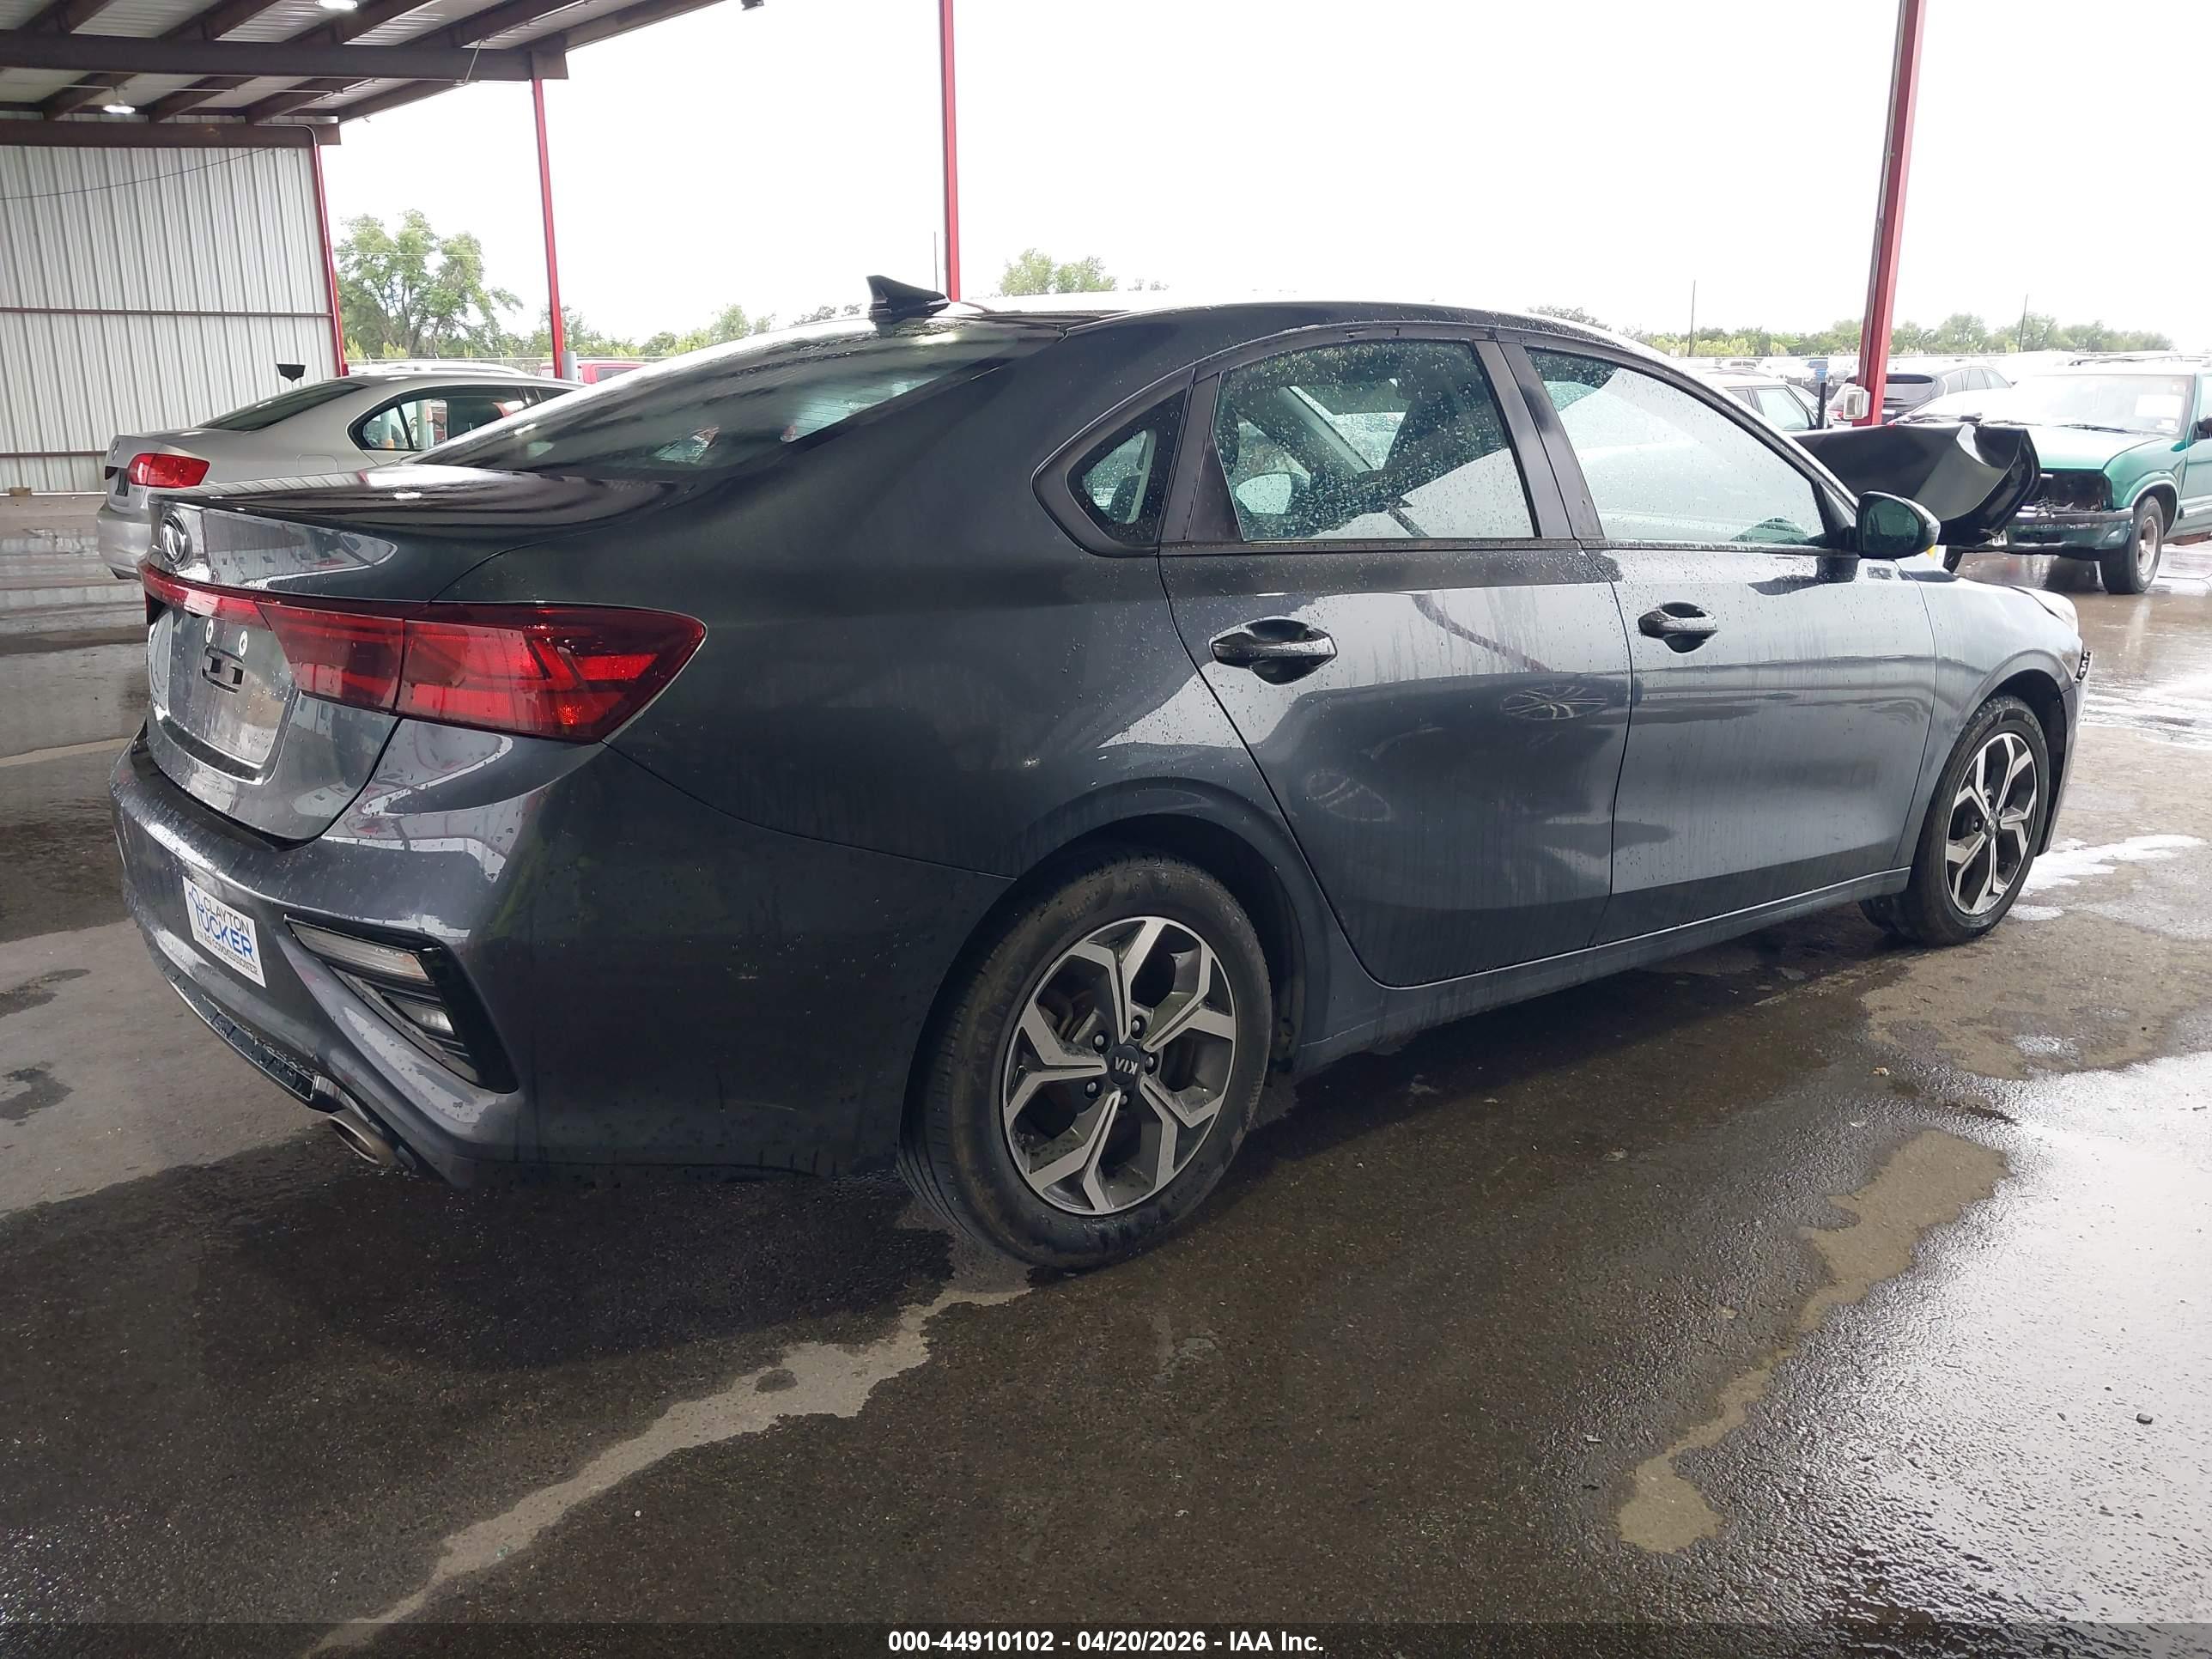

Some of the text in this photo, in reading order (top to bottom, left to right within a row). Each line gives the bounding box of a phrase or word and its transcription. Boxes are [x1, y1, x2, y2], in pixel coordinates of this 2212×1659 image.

[189, 885, 256, 963] TUCKER
[203, 896, 251, 937] CLAYTON
[1115, 1056, 1139, 1076] KIA
